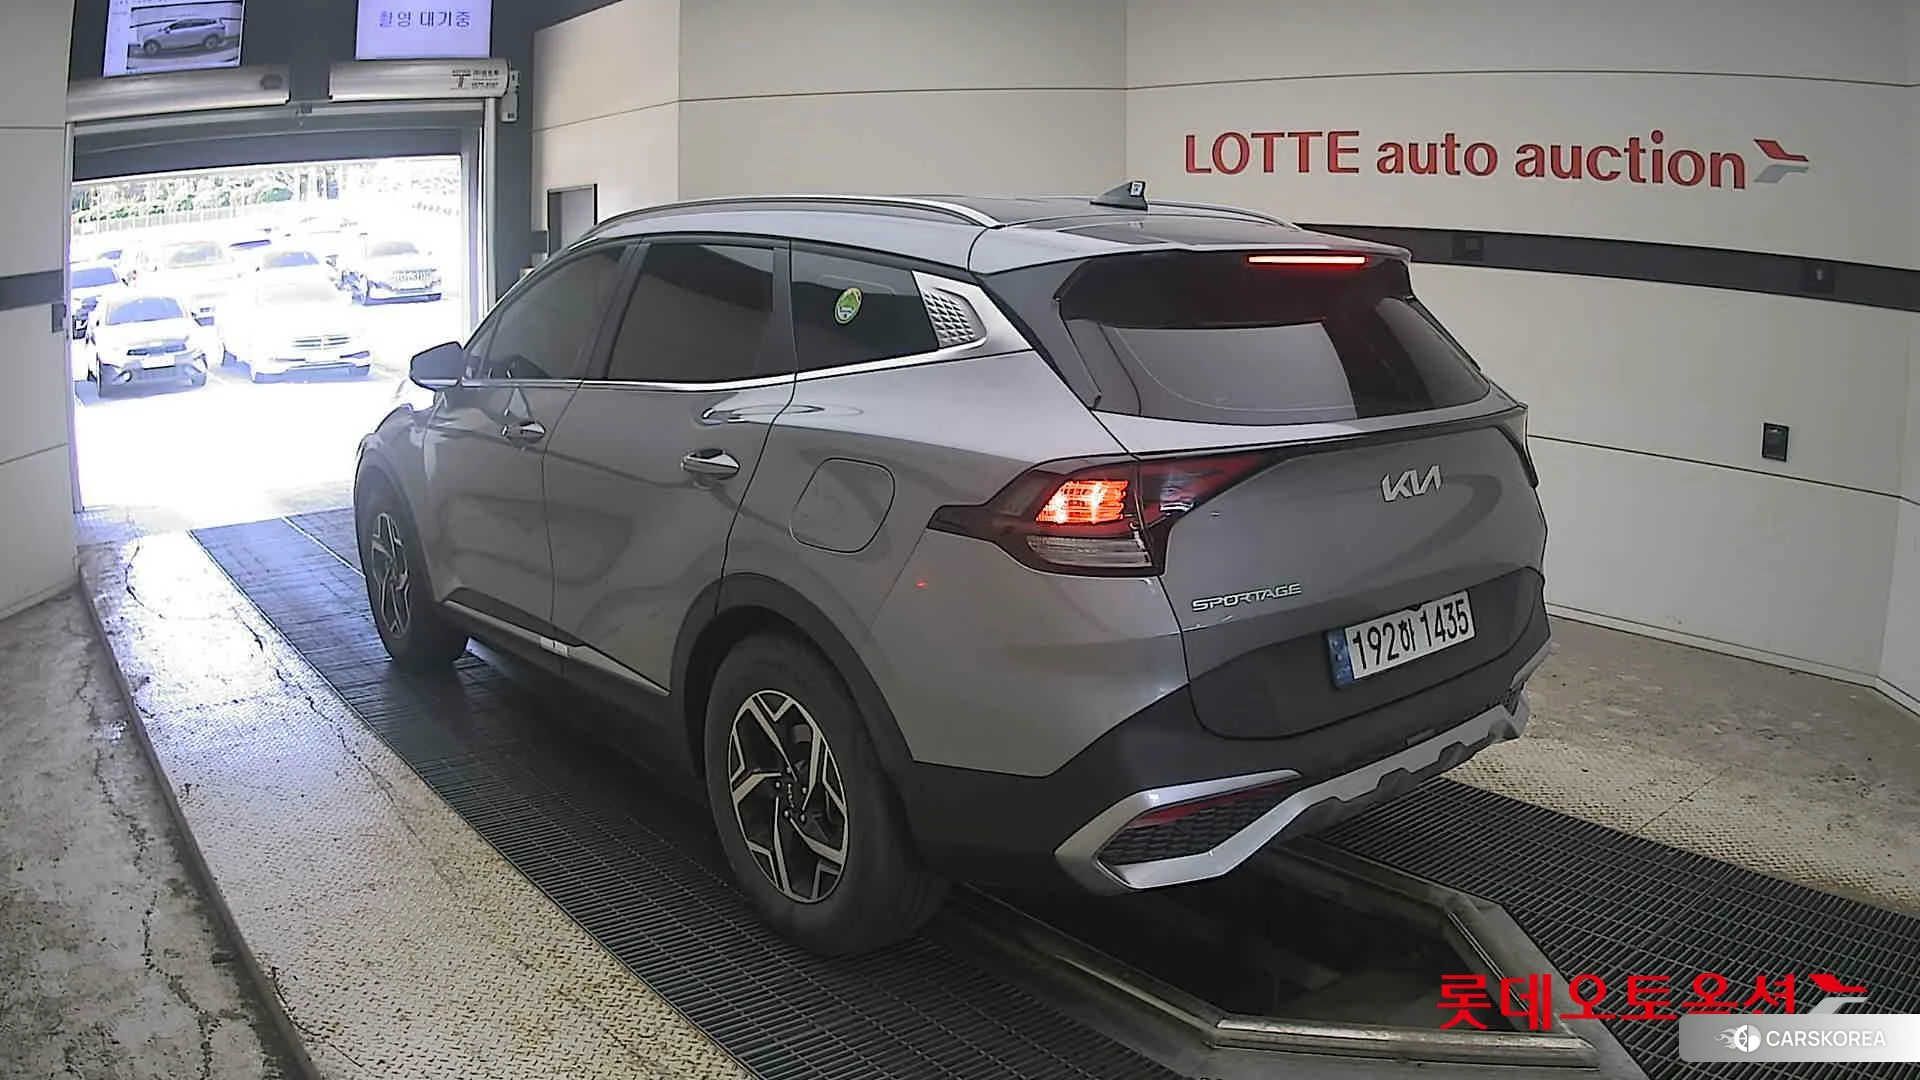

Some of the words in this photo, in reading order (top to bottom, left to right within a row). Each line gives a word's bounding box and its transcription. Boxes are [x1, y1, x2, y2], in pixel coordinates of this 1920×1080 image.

[420, 10, 471, 28] 대기중
[1184, 130, 1361, 176] LOTTE
[1376, 132, 1499, 177] auto
[1514, 128, 1747, 190] auction
[1382, 465, 1441, 502] KIA
[1192, 583, 1302, 612] SPORTAGE
[1353, 618, 1416, 670] 192하
[1420, 599, 1469, 647] 1435
